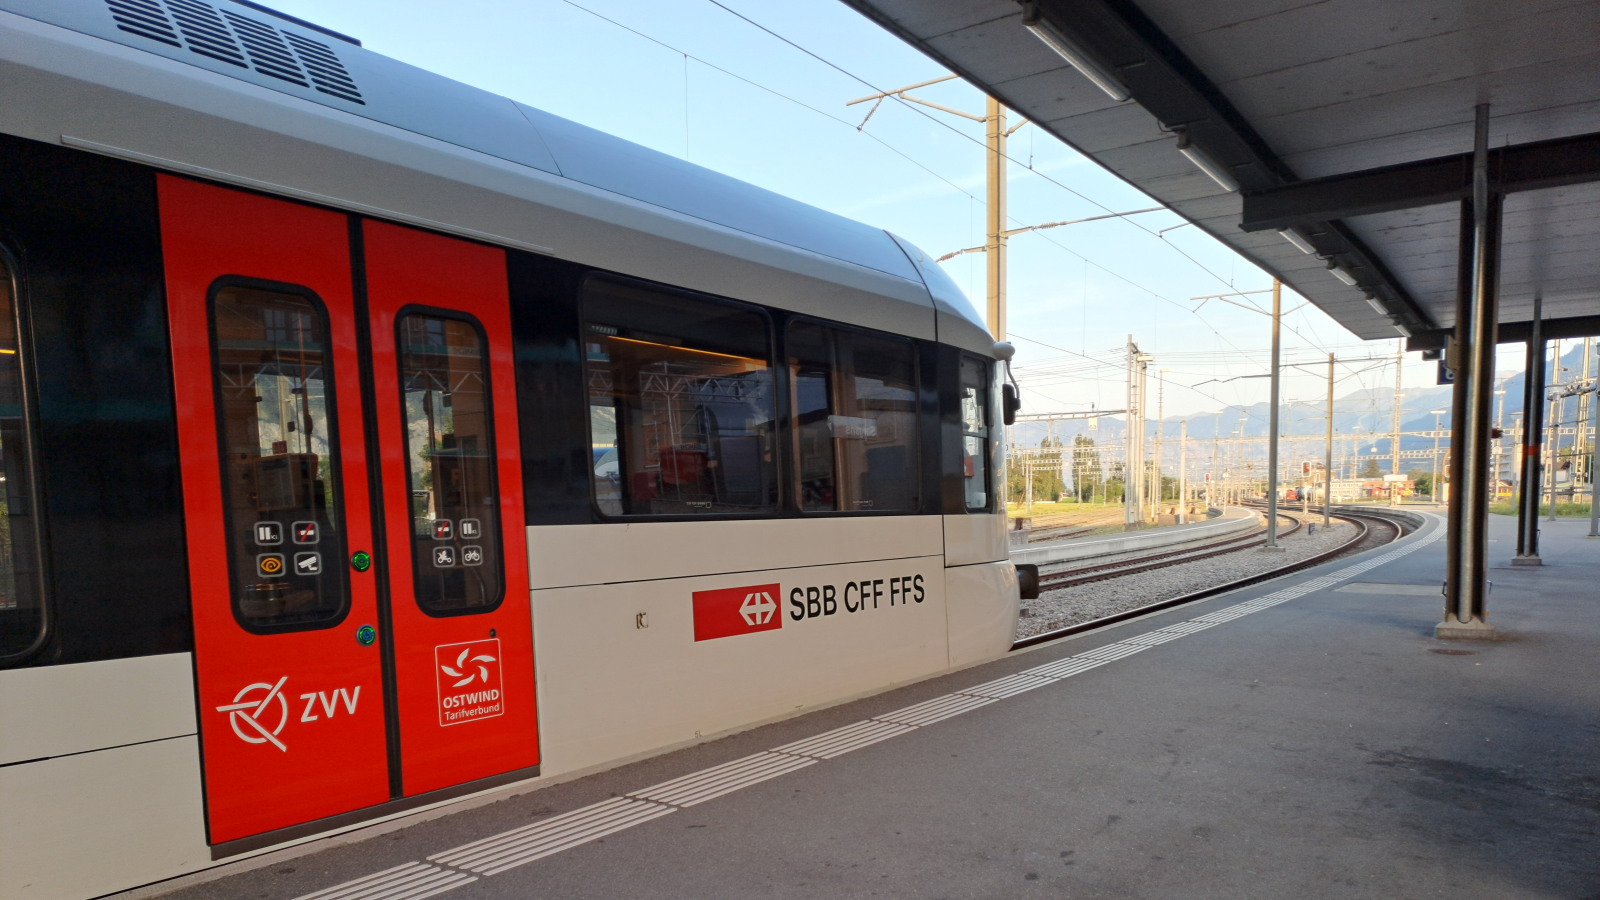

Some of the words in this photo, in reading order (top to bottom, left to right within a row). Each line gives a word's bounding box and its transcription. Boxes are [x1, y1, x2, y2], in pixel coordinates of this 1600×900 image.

[789, 585, 838, 621] SBB
[844, 578, 884, 613] CFF
[890, 574, 925, 606] FFS
[300, 685, 361, 723] ZVV
[443, 688, 500, 709] OSTWIND
[444, 702, 500, 721] Tarifverbund
